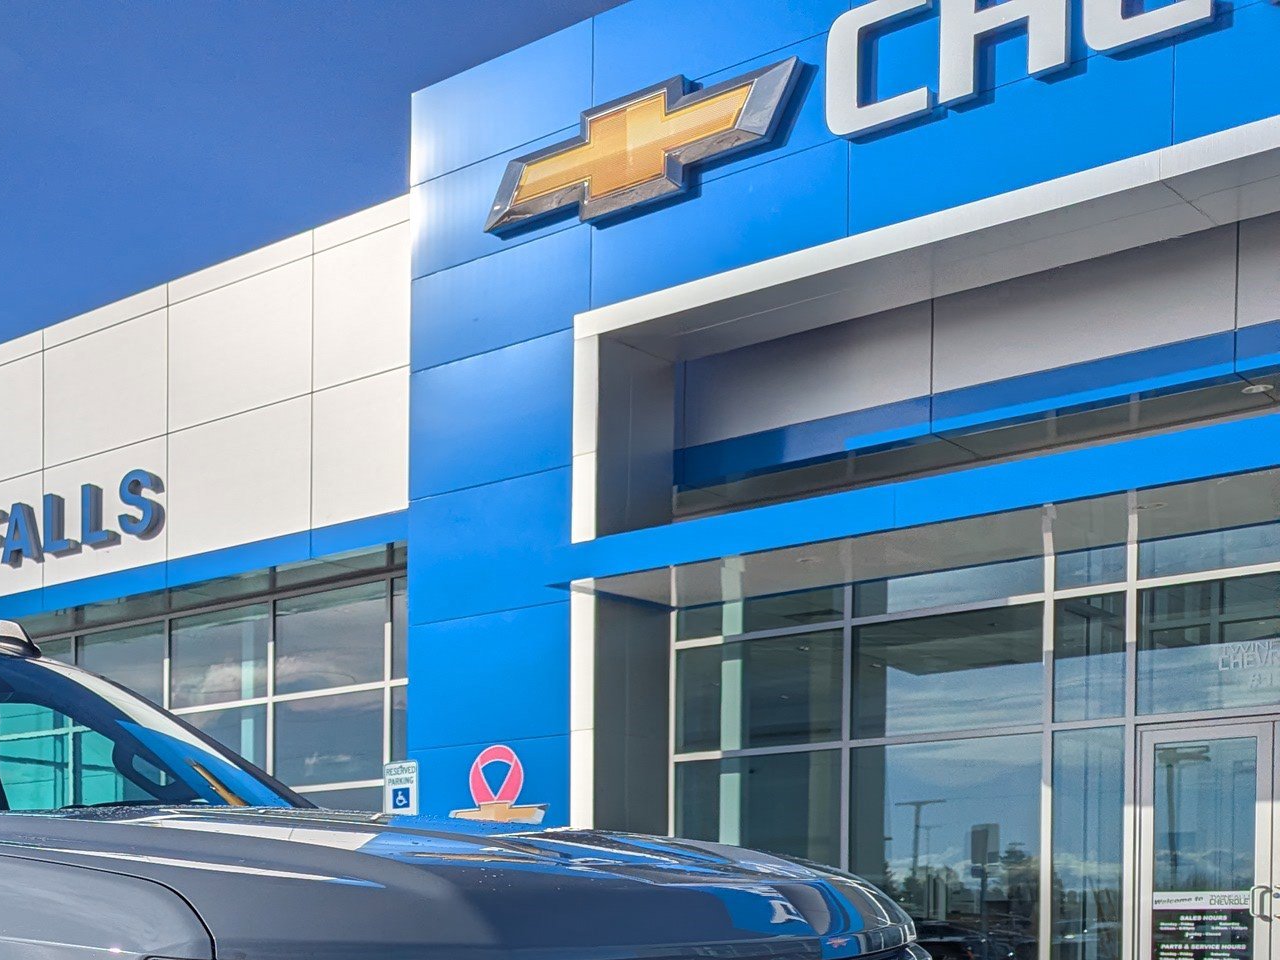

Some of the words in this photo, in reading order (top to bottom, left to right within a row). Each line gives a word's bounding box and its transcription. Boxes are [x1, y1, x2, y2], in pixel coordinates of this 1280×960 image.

[386, 765, 416, 775] RESERVED
[387, 776, 414, 785] PARKING
[1154, 897, 1192, 905] Welcome
